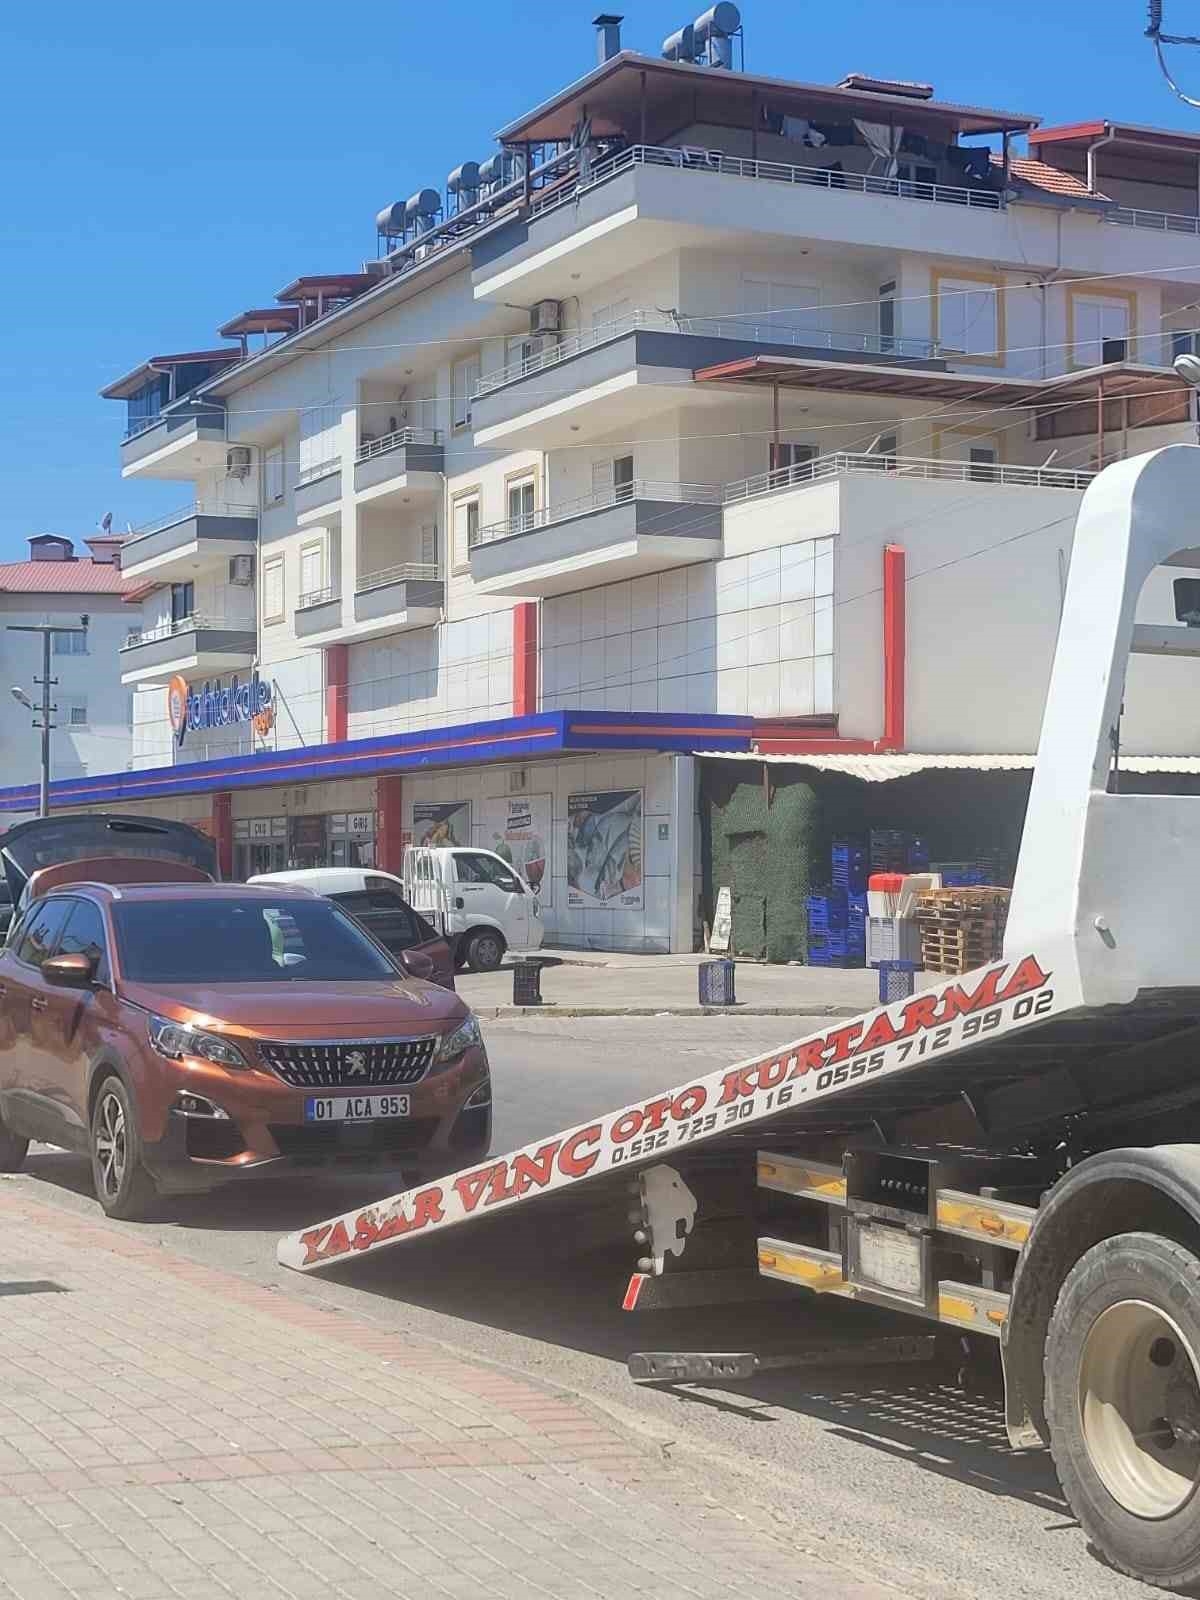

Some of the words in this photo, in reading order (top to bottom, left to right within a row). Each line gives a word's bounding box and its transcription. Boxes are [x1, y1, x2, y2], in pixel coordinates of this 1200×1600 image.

[316, 1100, 333, 1119] 01
[345, 1099, 372, 1117] ACA
[380, 1096, 409, 1114] 953
[609, 1085, 707, 1144] OTO
[713, 953, 1053, 1108] KURTARMA
[611, 1130, 670, 1165] 0.532
[676, 1111, 718, 1141] 723
[724, 1099, 755, 1125] 30
[765, 1084, 794, 1110] 16
[816, 1051, 886, 1091] 0555
[898, 1026, 952, 1063] 712
[962, 1006, 1002, 1040] 99
[1012, 989, 1054, 1020] 02
